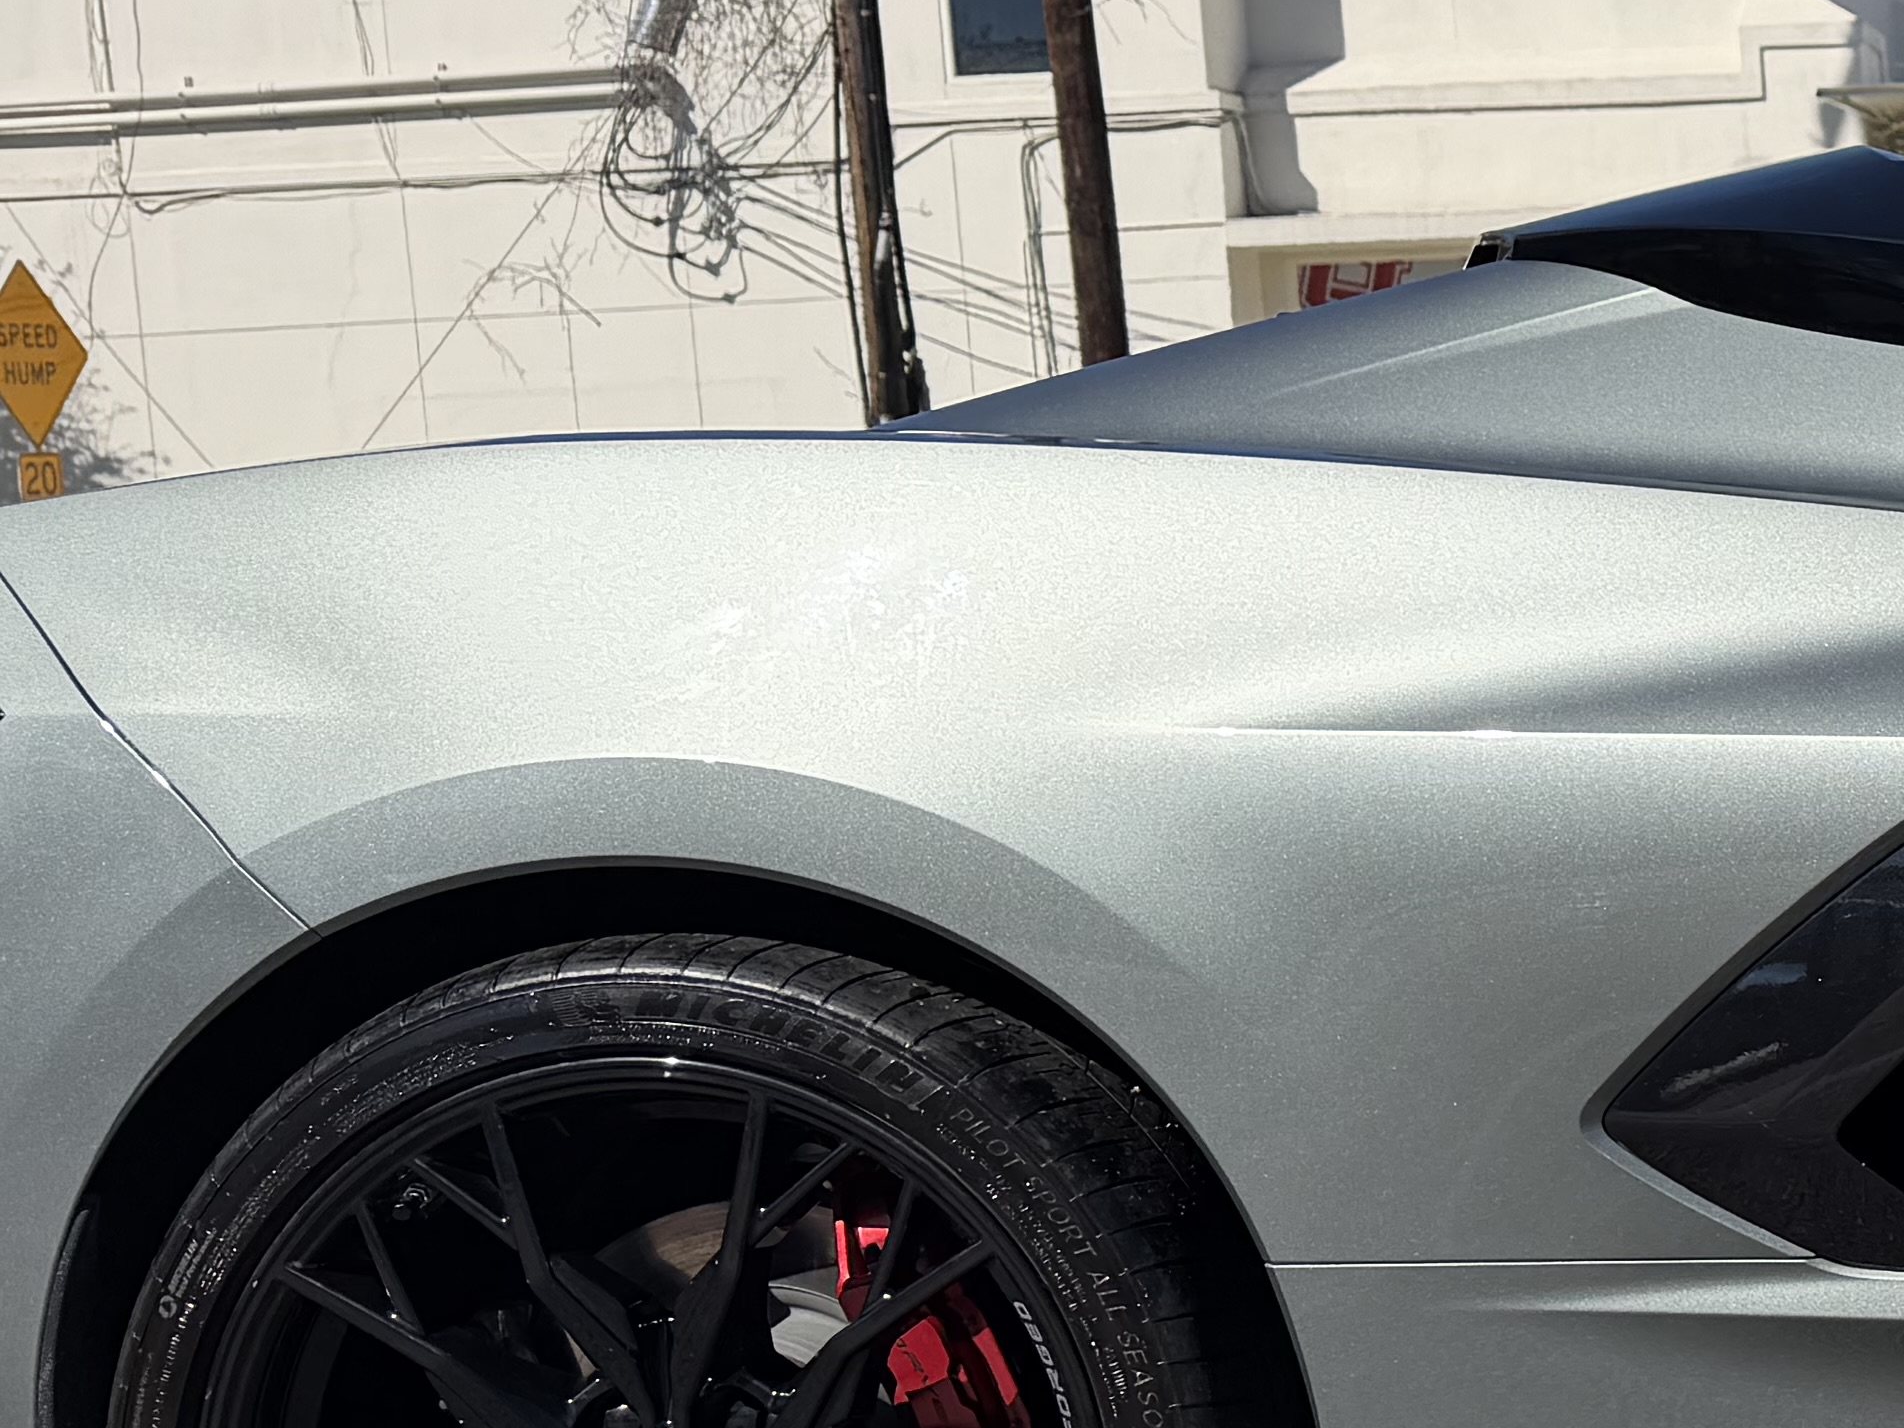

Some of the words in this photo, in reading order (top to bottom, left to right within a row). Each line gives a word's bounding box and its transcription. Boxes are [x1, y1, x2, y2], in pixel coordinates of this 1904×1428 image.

[4, 361, 57, 386] HUMP
[24, 461, 57, 496] 20
[634, 990, 924, 1093] MICHELIN
[949, 1106, 1025, 1169] PILOT
[1024, 1174, 1098, 1259] SPORT
[1090, 1270, 1129, 1322] ALL
